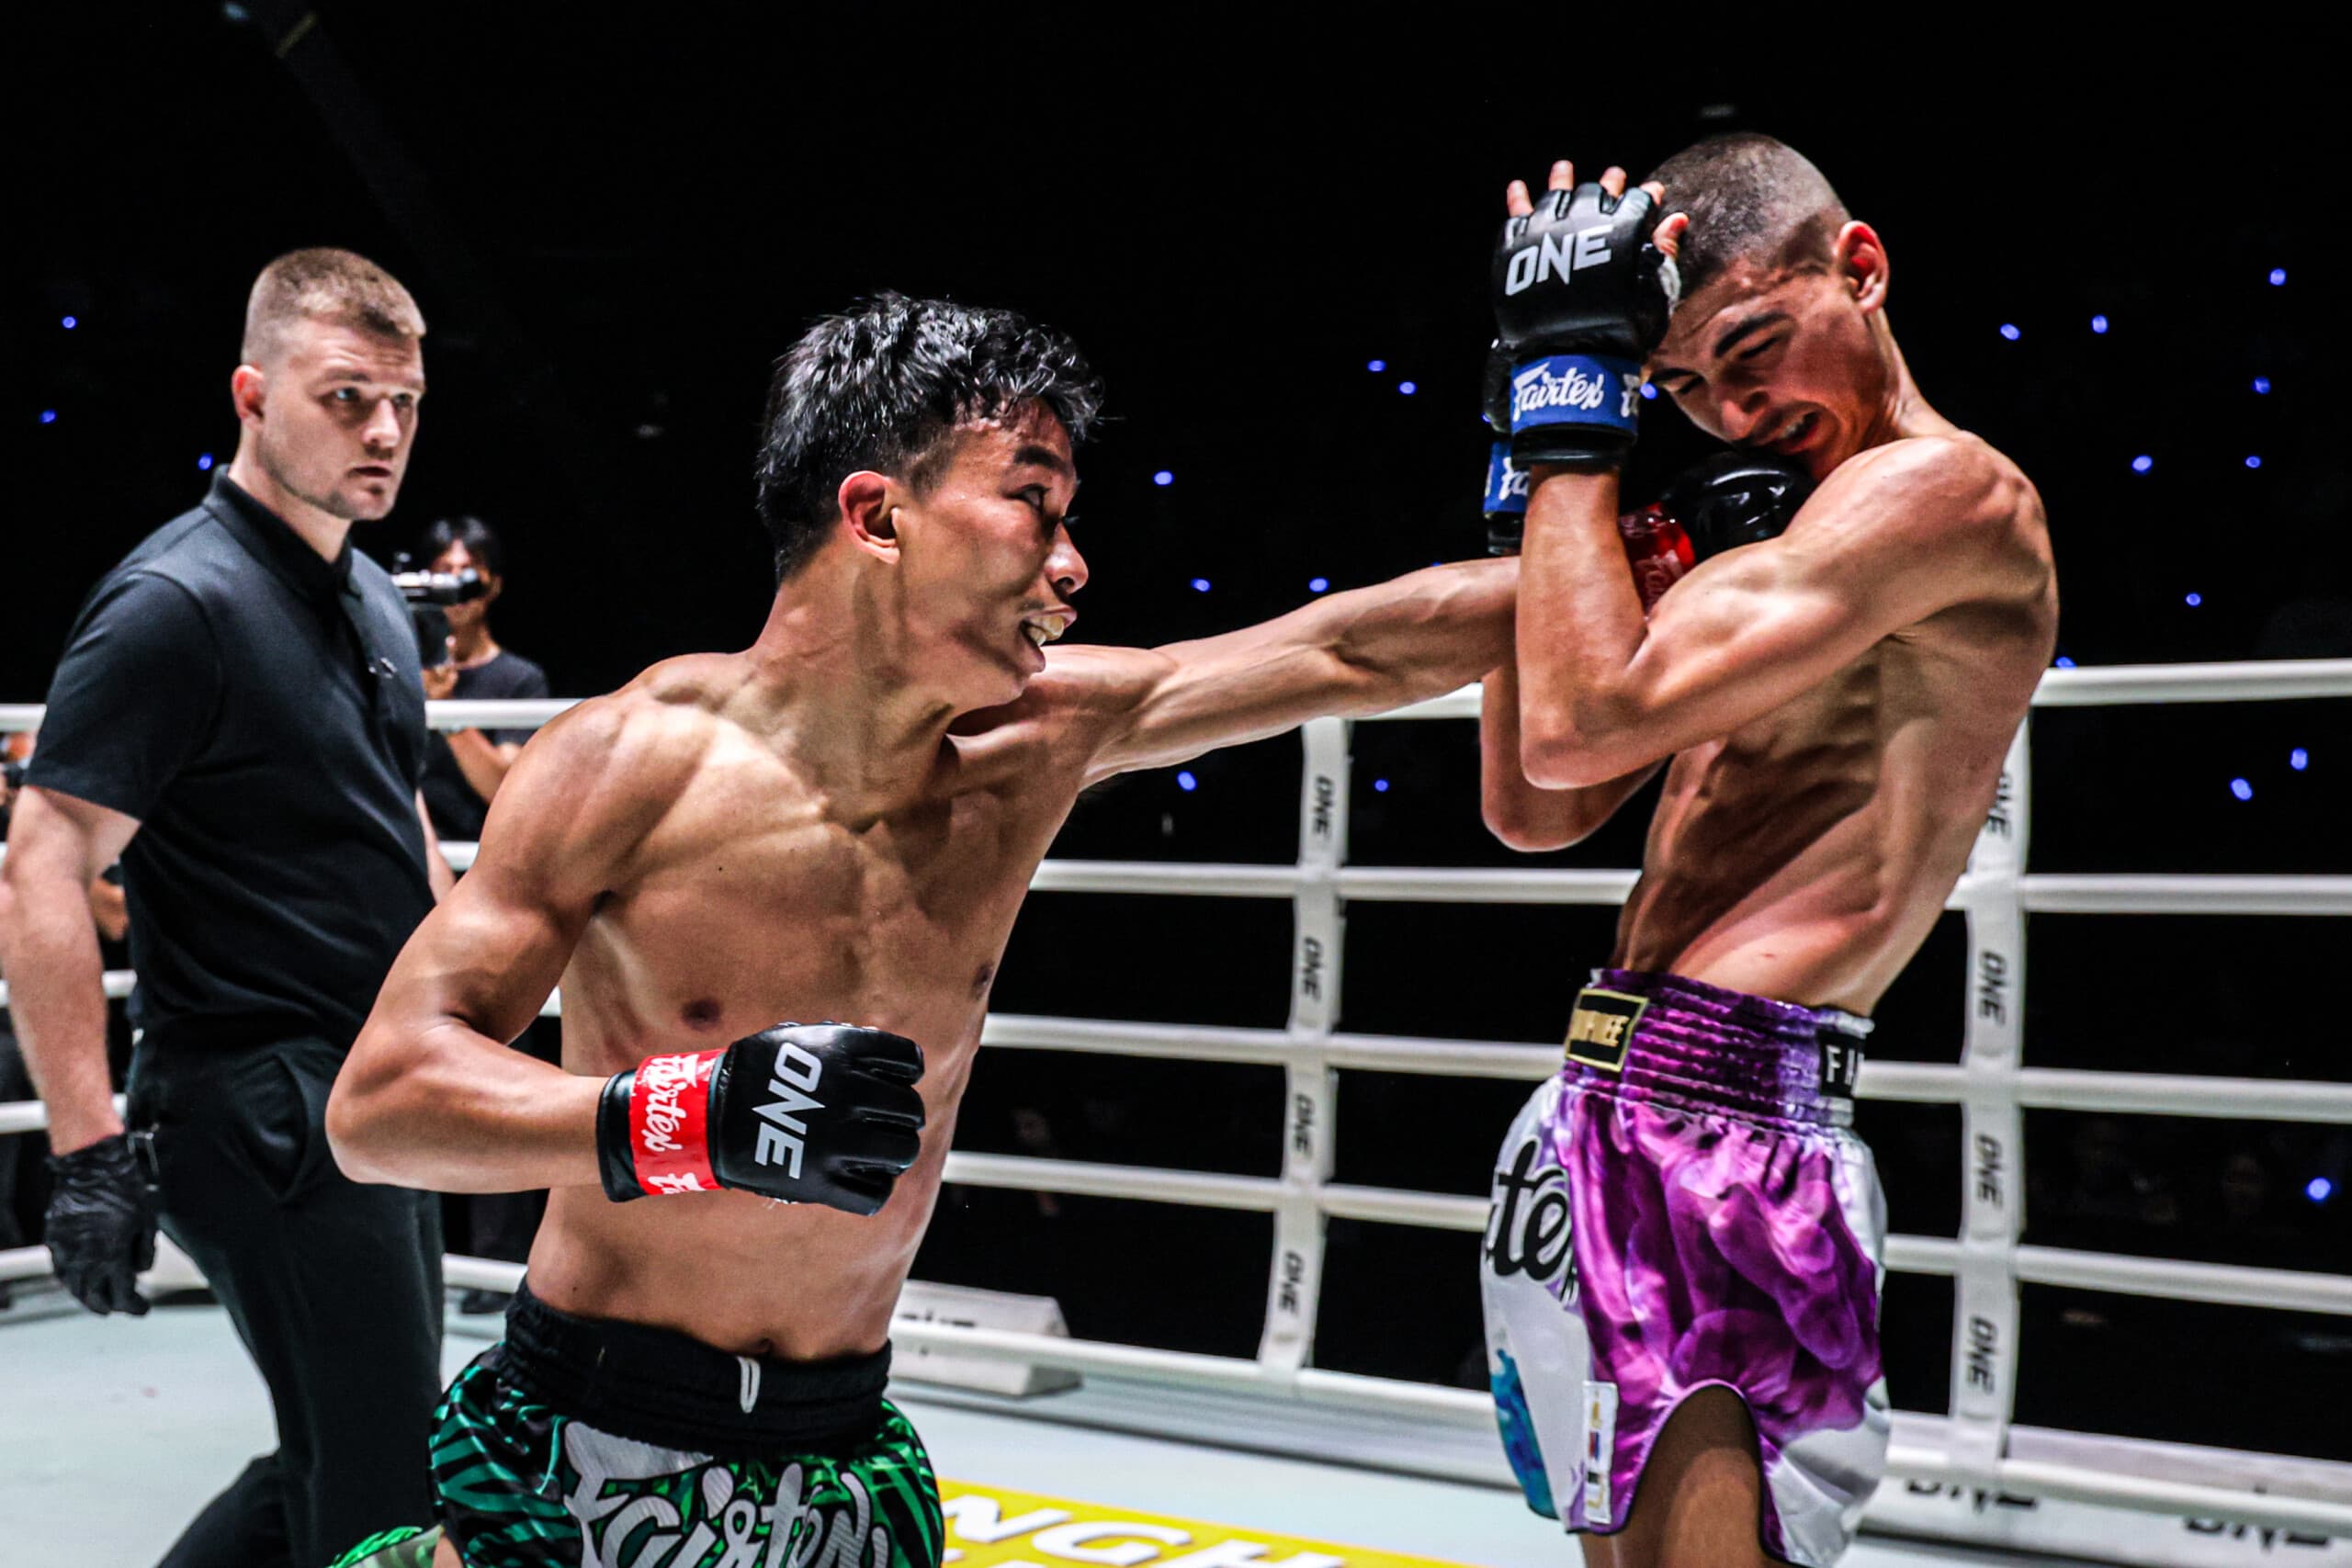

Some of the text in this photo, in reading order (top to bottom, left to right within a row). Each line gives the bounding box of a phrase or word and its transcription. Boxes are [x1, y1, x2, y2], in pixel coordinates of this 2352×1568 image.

[1505, 224, 1614, 296] ONE
[1513, 361, 1604, 423] Fairtex
[1313, 774, 1335, 840] ONE
[1303, 936, 1324, 1000] ONE
[1978, 950, 2007, 1026] ONE
[641, 1055, 700, 1153] Fairtex
[752, 1042, 825, 1179] ONE
[1294, 1093, 1315, 1158] ONE
[1974, 1133, 2003, 1210] ONE
[1280, 1251, 1305, 1317] ONE
[1966, 1314, 1998, 1394] ONE
